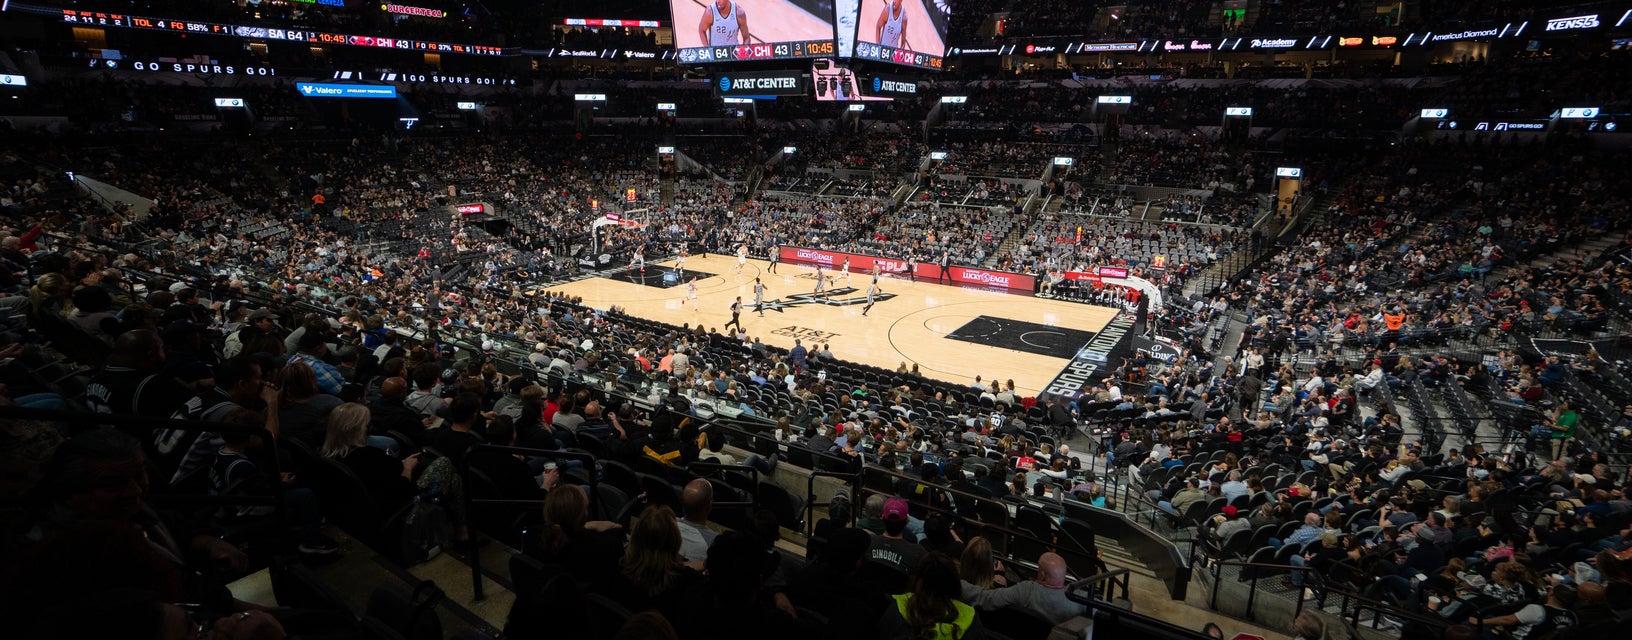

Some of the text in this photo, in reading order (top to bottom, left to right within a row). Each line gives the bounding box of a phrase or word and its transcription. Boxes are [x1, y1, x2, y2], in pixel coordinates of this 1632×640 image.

[387, 4, 443, 18] BURGERTECA
[132, 18, 165, 28] TOL 4
[170, 21, 209, 32] FG 58%
[213, 25, 220, 33] F
[268, 29, 285, 39] SA
[287, 31, 303, 41] 64
[716, 26, 727, 34] 22
[1432, 28, 1498, 41] Americus Diamond
[319, 33, 345, 43] 10:45
[376, 38, 409, 49] CHI 43
[698, 48, 728, 60] SA 64
[754, 46, 771, 57] CHI
[774, 45, 788, 56] 43
[807, 42, 833, 54] 10:45
[870, 46, 890, 59] SA 64
[904, 52, 922, 65] CHI 43
[134, 61, 275, 76] GO SPURS GO!
[409, 74, 495, 85] GO SPURS GO!
[732, 77, 796, 89] AT&T CENTER
[315, 86, 343, 94] Valero
[881, 80, 916, 93] AT&T CENTER
[818, 253, 834, 261] EAGLE
[963, 271, 1010, 284] LUCKY EAGLE
[780, 325, 842, 339] AT&T
[1080, 325, 1127, 362] ANTONIO
[1047, 361, 1098, 397] SPURS
[990, 417, 1001, 427] 20
[872, 549, 902, 565] GINOBILI
